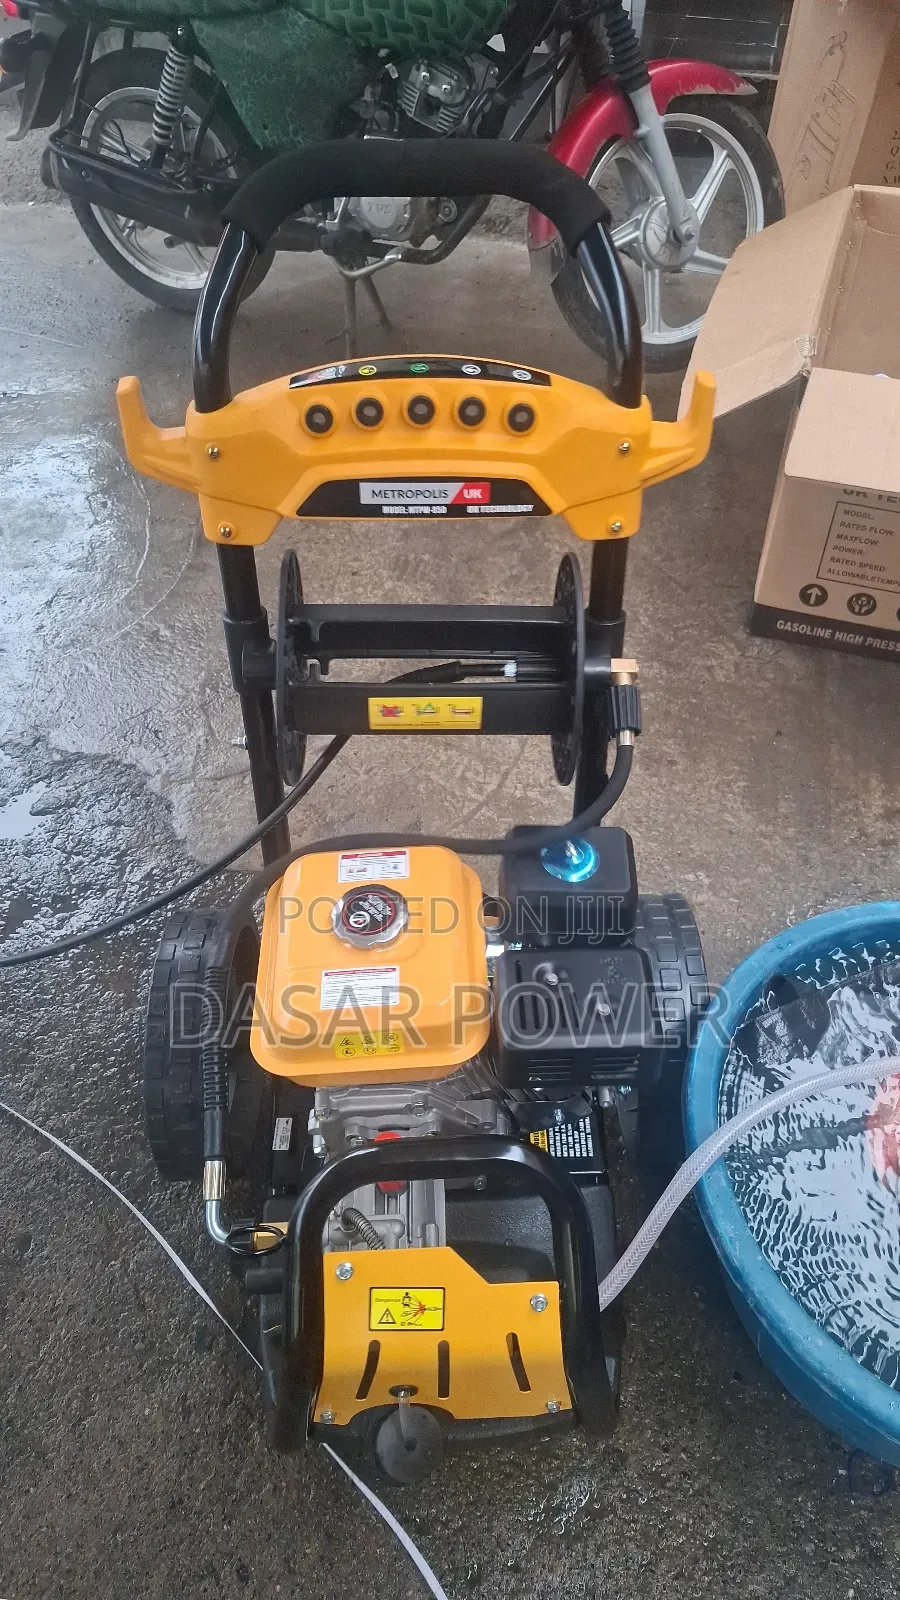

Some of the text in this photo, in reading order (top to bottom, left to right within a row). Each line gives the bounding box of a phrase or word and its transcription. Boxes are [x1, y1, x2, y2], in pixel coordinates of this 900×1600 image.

[371, 488, 483, 499] METROPOLIS UK
[843, 508, 875, 521] MODEL:
[839, 521, 895, 537] RATED FLOW:
[835, 533, 879, 547] MAXFLOW:
[832, 545, 864, 557] POWER:
[829, 556, 888, 573] RATED SPEED:
[776, 619, 832, 639] GASOLINE
[834, 631, 864, 645] HIGH
